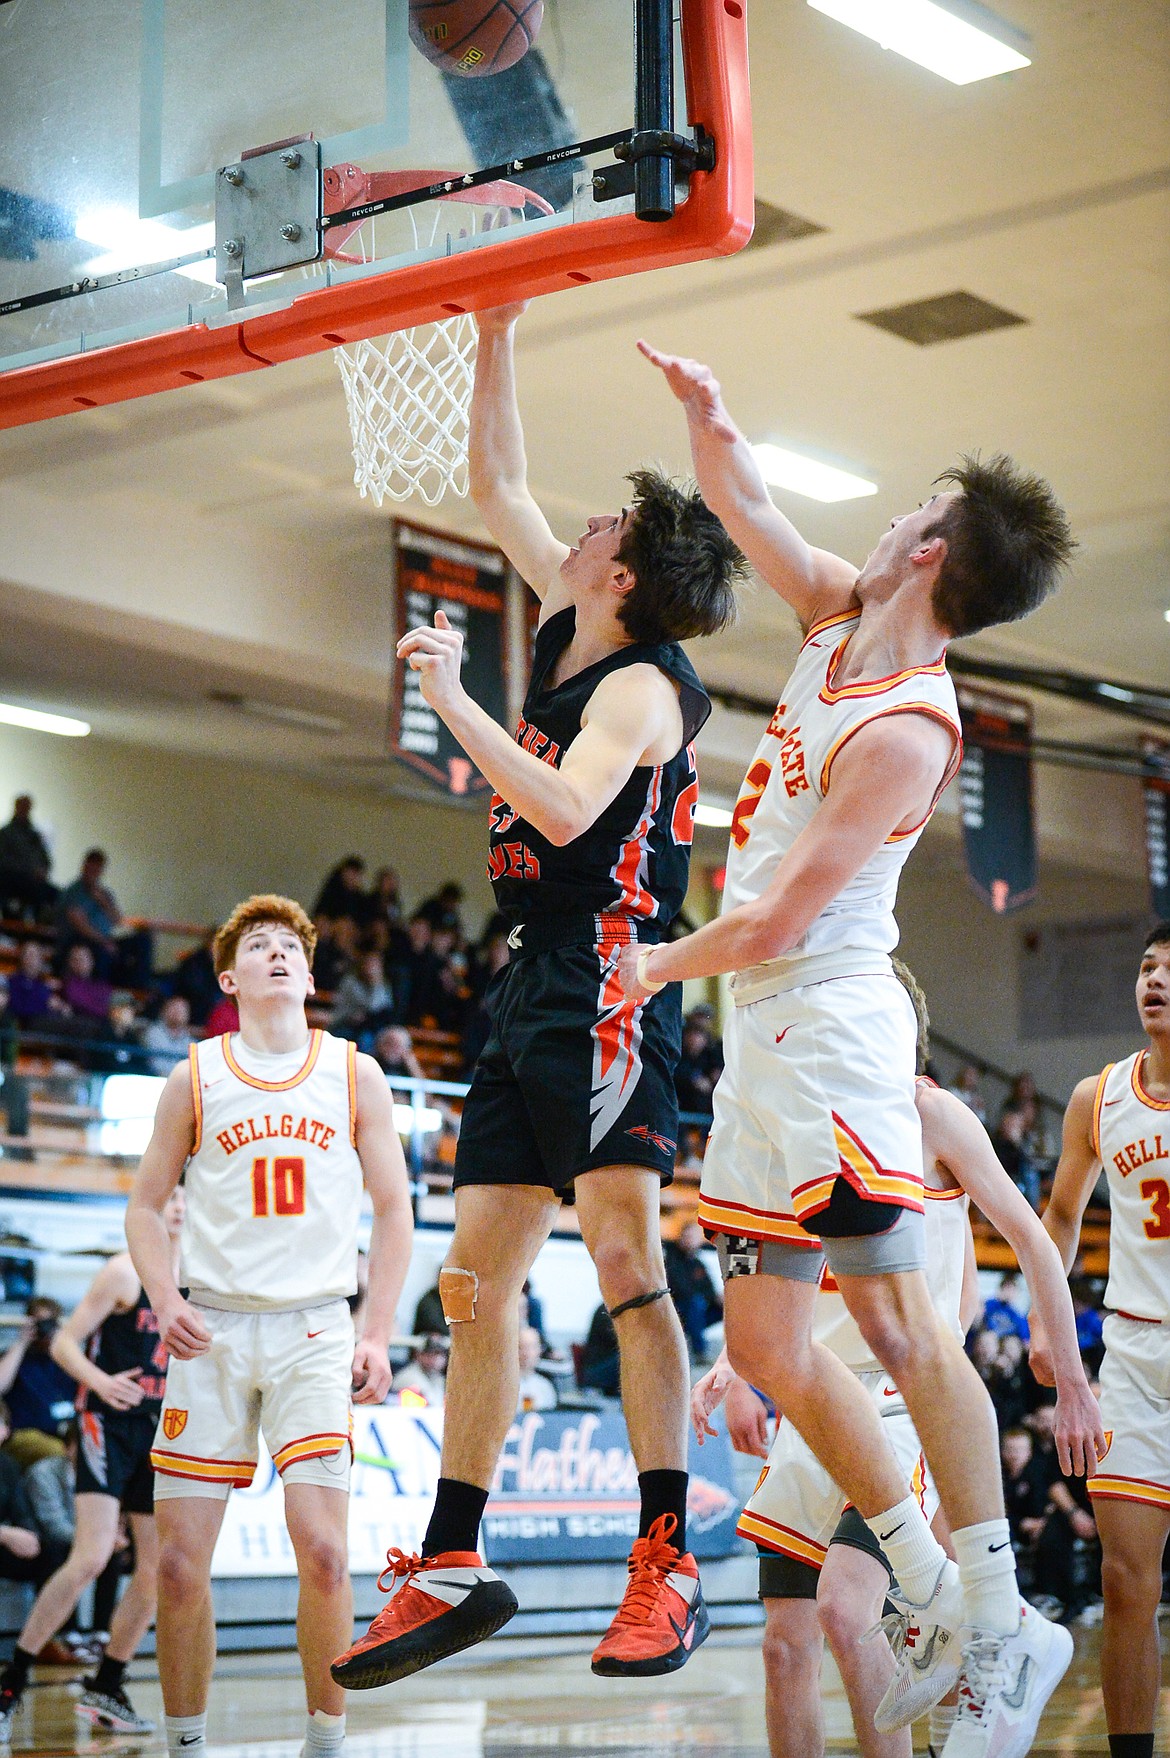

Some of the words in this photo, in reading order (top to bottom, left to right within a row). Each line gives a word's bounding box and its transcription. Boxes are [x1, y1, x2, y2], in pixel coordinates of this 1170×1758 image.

[458, 48, 482, 71] PRO
[730, 758, 773, 852] 2
[216, 1114, 336, 1156] HELLGATE
[1113, 1135, 1170, 1178] HELL
[251, 1156, 307, 1219] 10
[486, 1517, 560, 1540] HIGH
